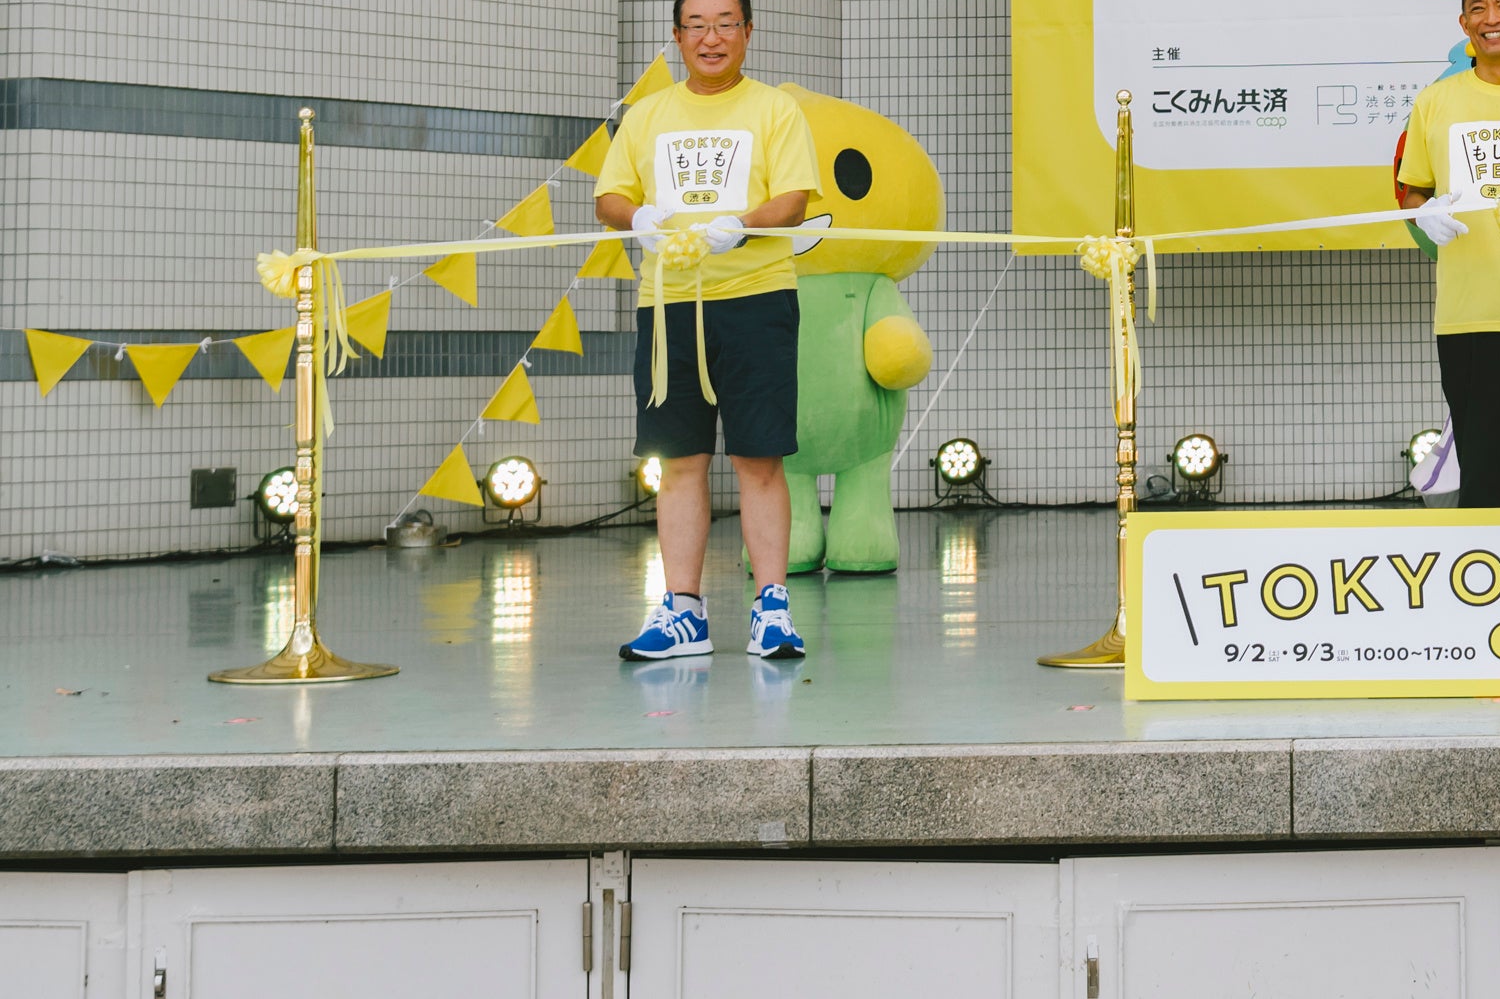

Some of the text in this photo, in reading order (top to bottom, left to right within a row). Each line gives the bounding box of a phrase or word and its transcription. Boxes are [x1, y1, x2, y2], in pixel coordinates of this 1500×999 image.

[1152, 47, 1181, 61] 主催
[1152, 88, 1288, 114] こくみん共済
[672, 137, 733, 151] TOKYO
[676, 151, 725, 169] もしも
[678, 169, 723, 187] FES
[1224, 643, 1265, 662] 9/2
[1293, 643, 1334, 662] 9/3
